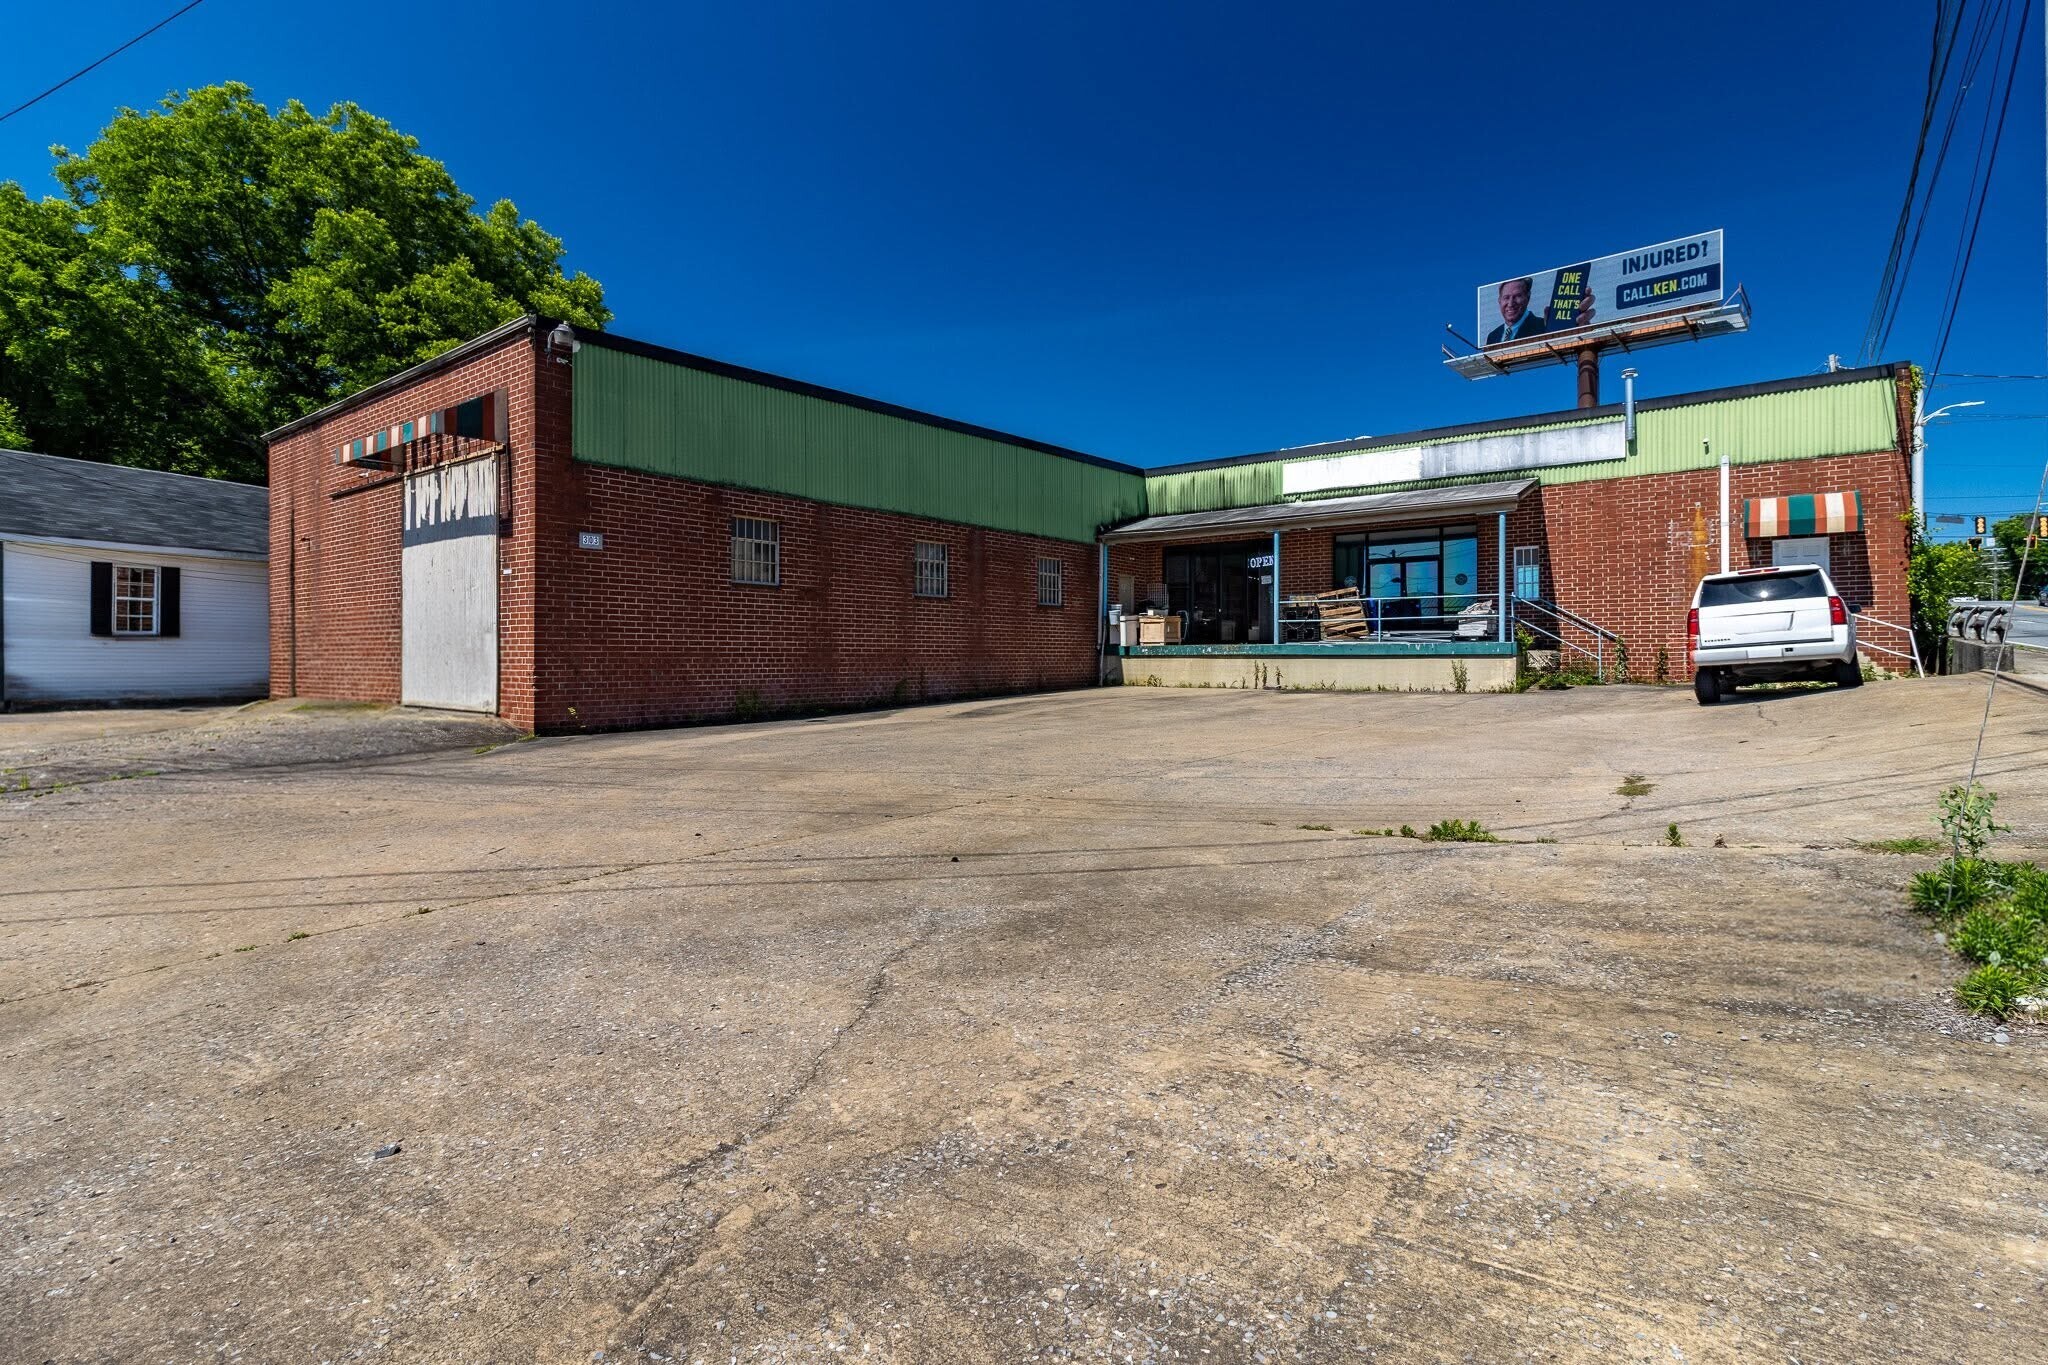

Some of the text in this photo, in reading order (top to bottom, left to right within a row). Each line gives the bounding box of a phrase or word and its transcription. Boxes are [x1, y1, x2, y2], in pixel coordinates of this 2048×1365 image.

[1622, 240, 1708, 275] INJURED?
[1562, 272, 1582, 284] ONE
[1557, 284, 1581, 296] CALL
[1623, 273, 1708, 302] CALLKEN.COM
[1553, 299, 1580, 310] THAT'S
[1555, 310, 1572, 320] ALL
